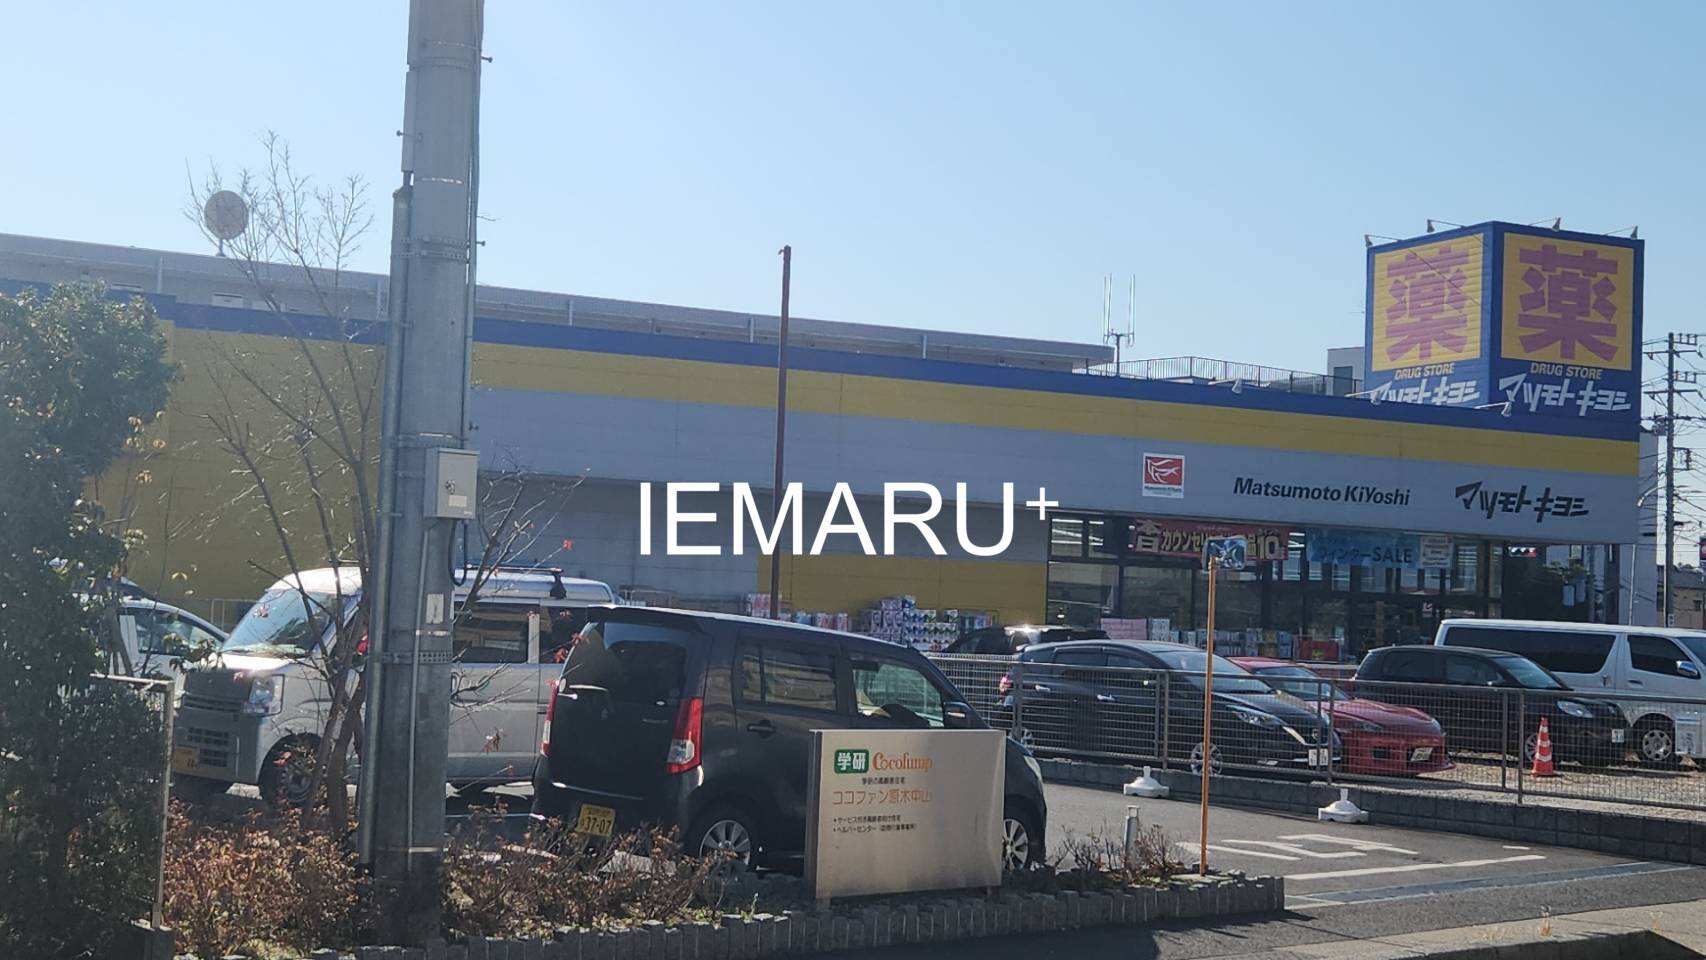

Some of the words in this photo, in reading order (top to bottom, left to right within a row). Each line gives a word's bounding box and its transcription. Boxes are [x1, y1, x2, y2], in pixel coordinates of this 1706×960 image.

[1386, 245, 1469, 362] 薬
[1518, 244, 1618, 362] 薬
[1394, 367, 1421, 380] DRUG
[1424, 362, 1456, 376] STORE
[1530, 362, 1562, 376] DRUG
[1566, 367, 1603, 380] STORE
[1499, 373, 1631, 416] マツモトキヨシ
[1233, 477, 1341, 501] Matsumoto
[1344, 485, 1411, 506] KiYoshi
[1455, 481, 1589, 523] マツモトキヨシ
[837, 752, 866, 770] 学研
